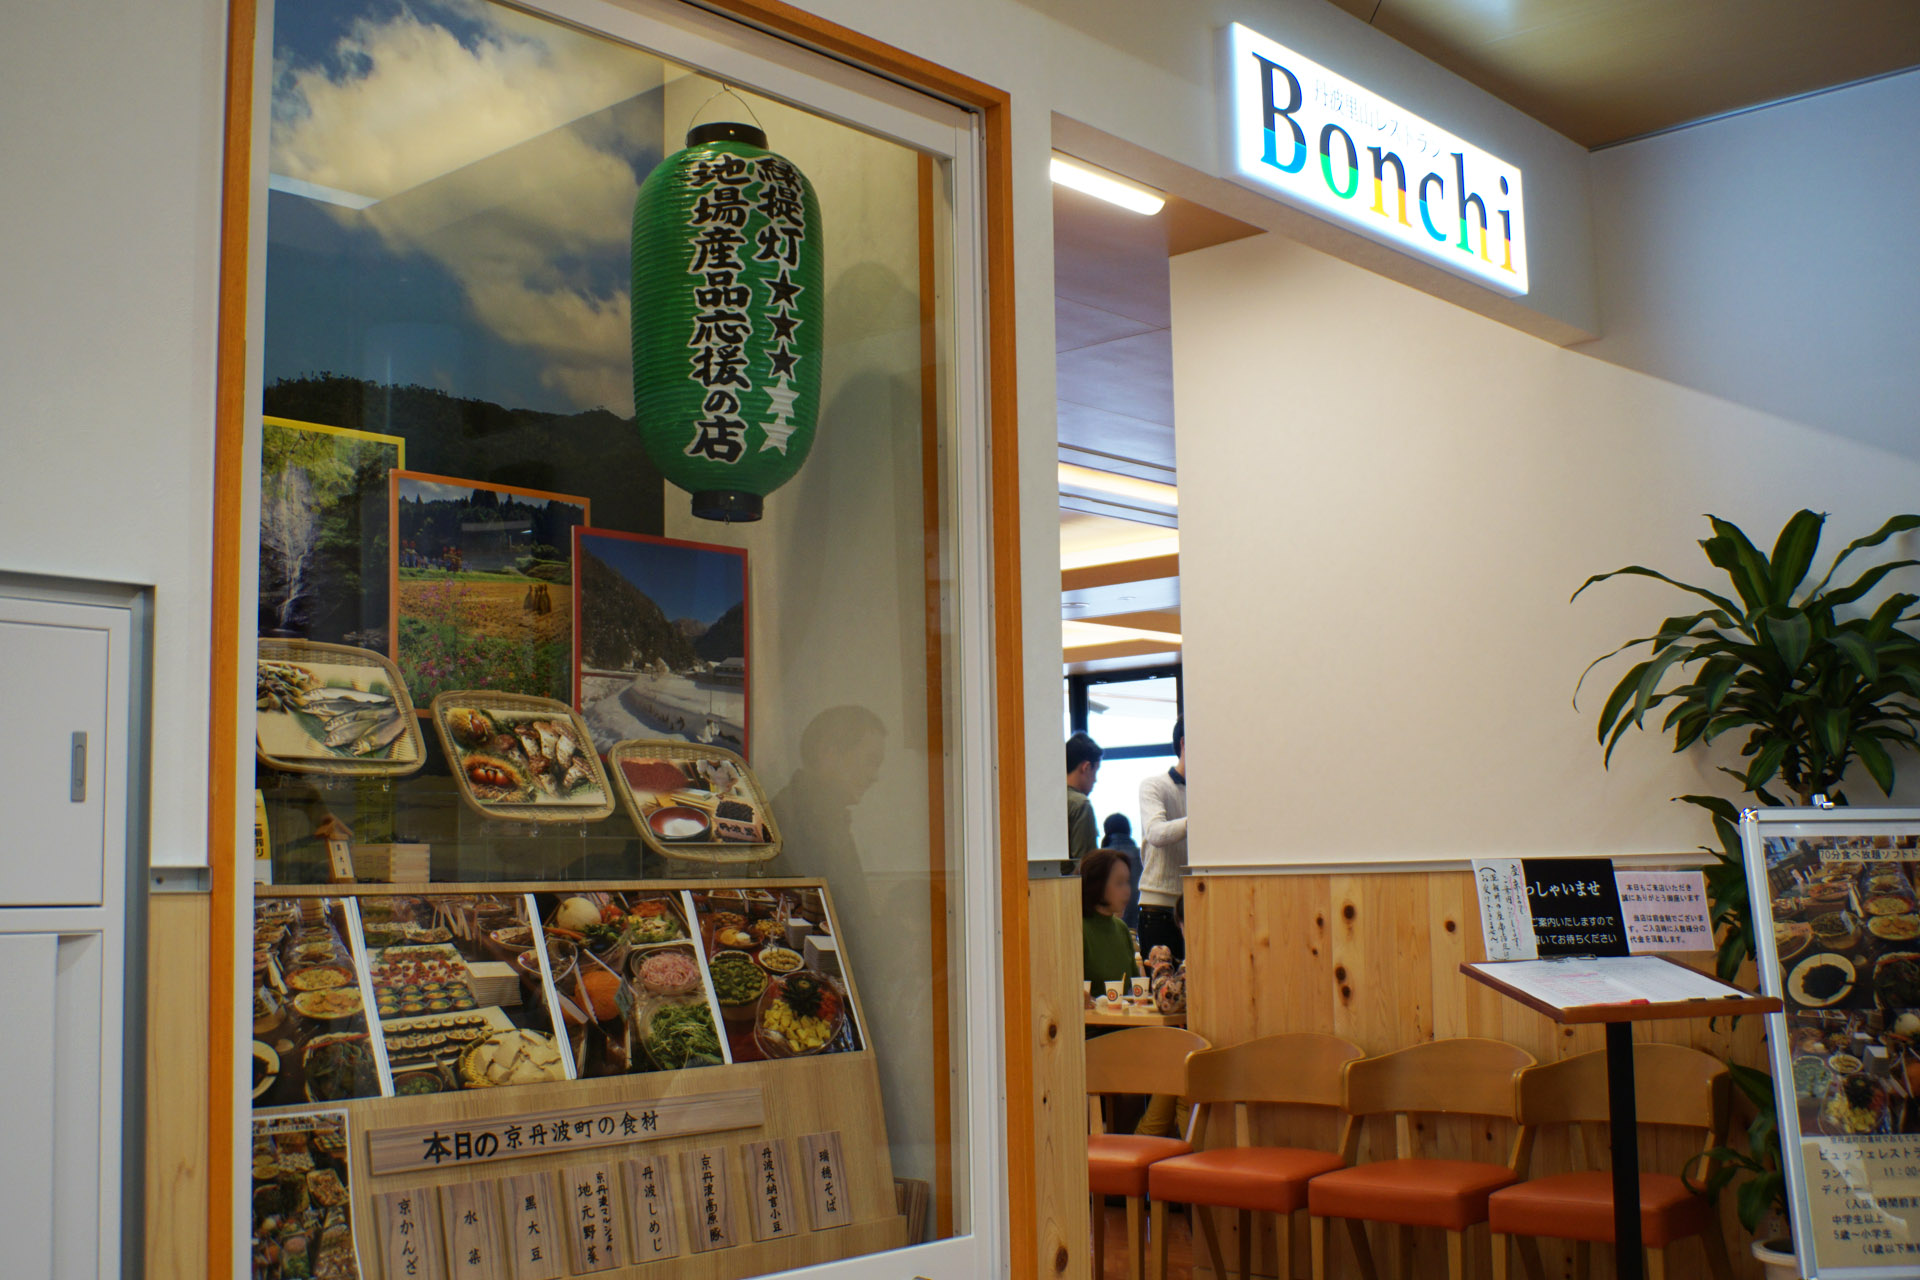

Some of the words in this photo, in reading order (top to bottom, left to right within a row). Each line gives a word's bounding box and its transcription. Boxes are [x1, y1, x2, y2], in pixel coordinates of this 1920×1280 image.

[1252, 51, 1517, 274] Bonchi
[752, 157, 804, 266] 緑提灯
[689, 154, 751, 464] 地場産品応援の店
[423, 1110, 659, 1164] 本日の京丹波町の食材
[525, 1195, 543, 1262] 黒大豆
[578, 1182, 600, 1265] 地元野菜
[642, 1166, 662, 1252] 丹波しめじ
[762, 1147, 782, 1233] 丹波大納言小豆
